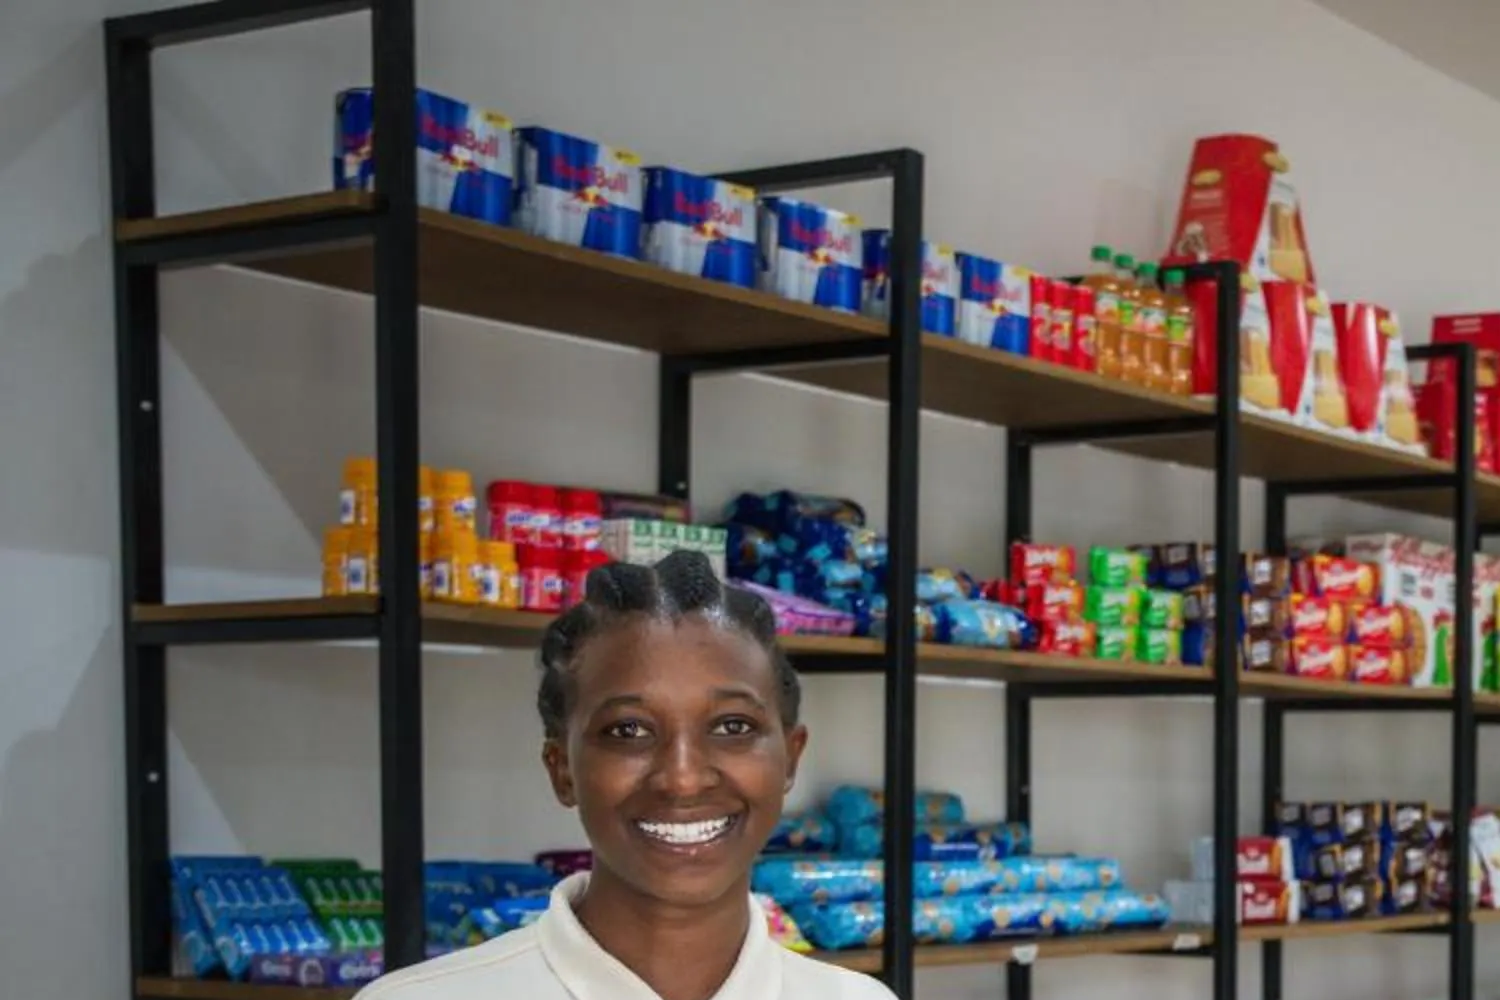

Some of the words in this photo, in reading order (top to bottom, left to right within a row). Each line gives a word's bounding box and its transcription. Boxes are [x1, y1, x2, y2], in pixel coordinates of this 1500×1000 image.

[462, 128, 499, 157] Bull
[592, 166, 628, 194] Bull
[708, 201, 743, 227] Bull
[822, 229, 852, 254] Bull
